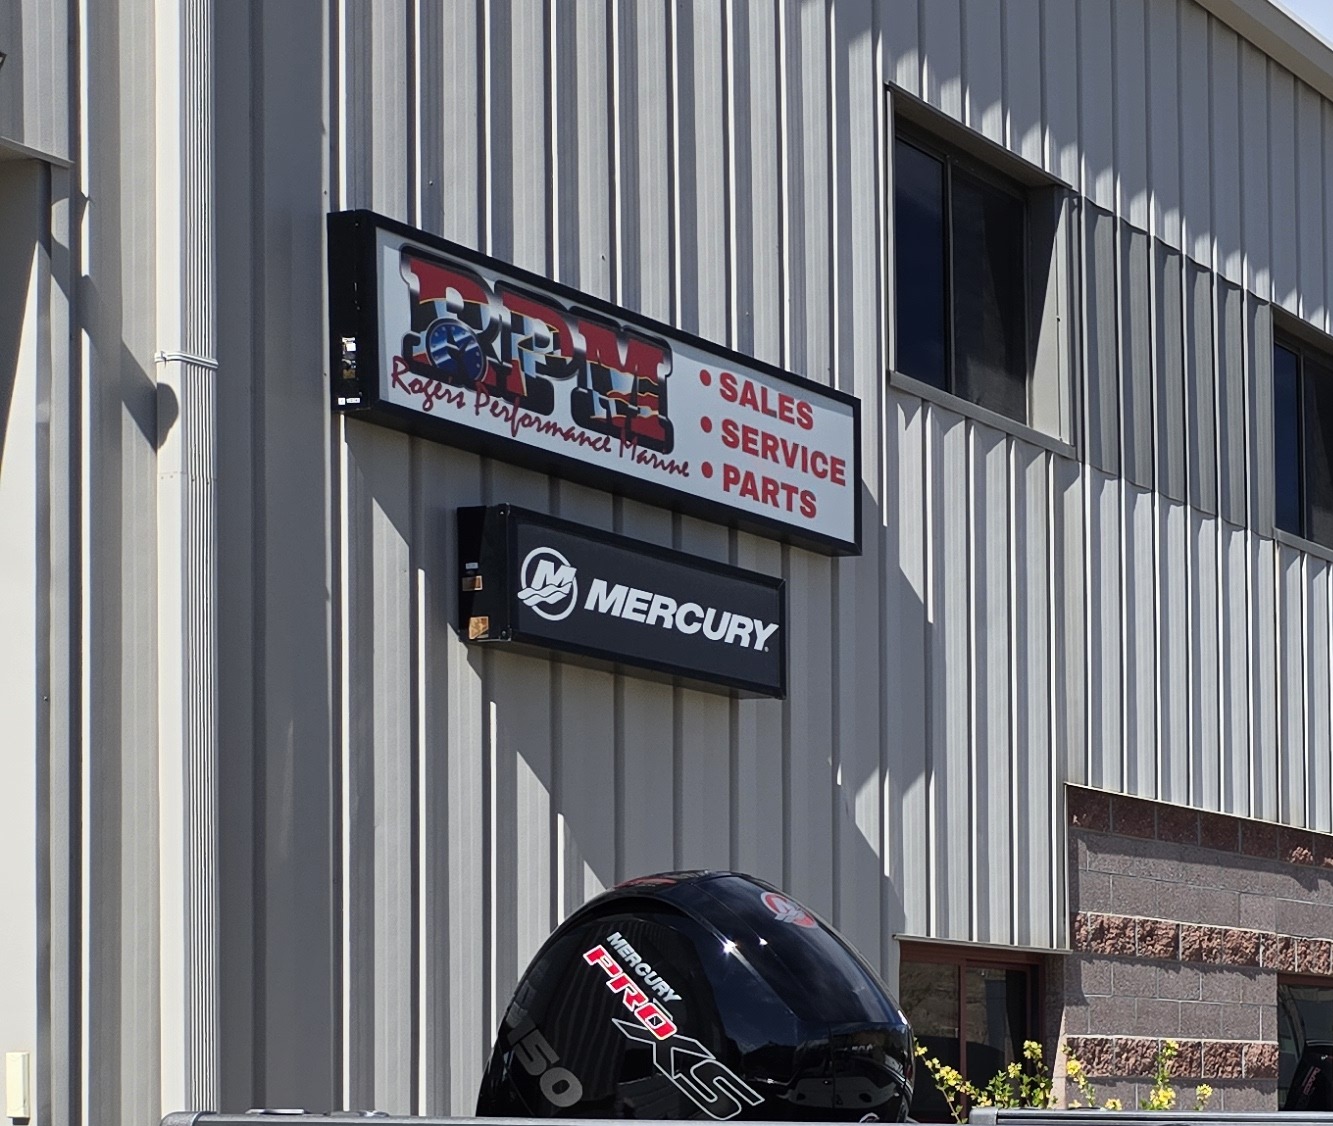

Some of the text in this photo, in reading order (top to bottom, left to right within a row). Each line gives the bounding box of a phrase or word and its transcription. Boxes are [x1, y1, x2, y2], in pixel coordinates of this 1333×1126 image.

[401, 244, 675, 454] RPM
[391, 355, 690, 477] Rogers Performance Marine
[719, 372, 813, 430] SALES
[721, 418, 846, 487] SERVICE
[722, 463, 817, 519] PARTS
[584, 578, 779, 652] MERCURY
[583, 944, 677, 1040] PRO
[606, 932, 682, 1002] MERCURY
[506, 1022, 583, 1107] 150
[612, 999, 765, 1120] XS
